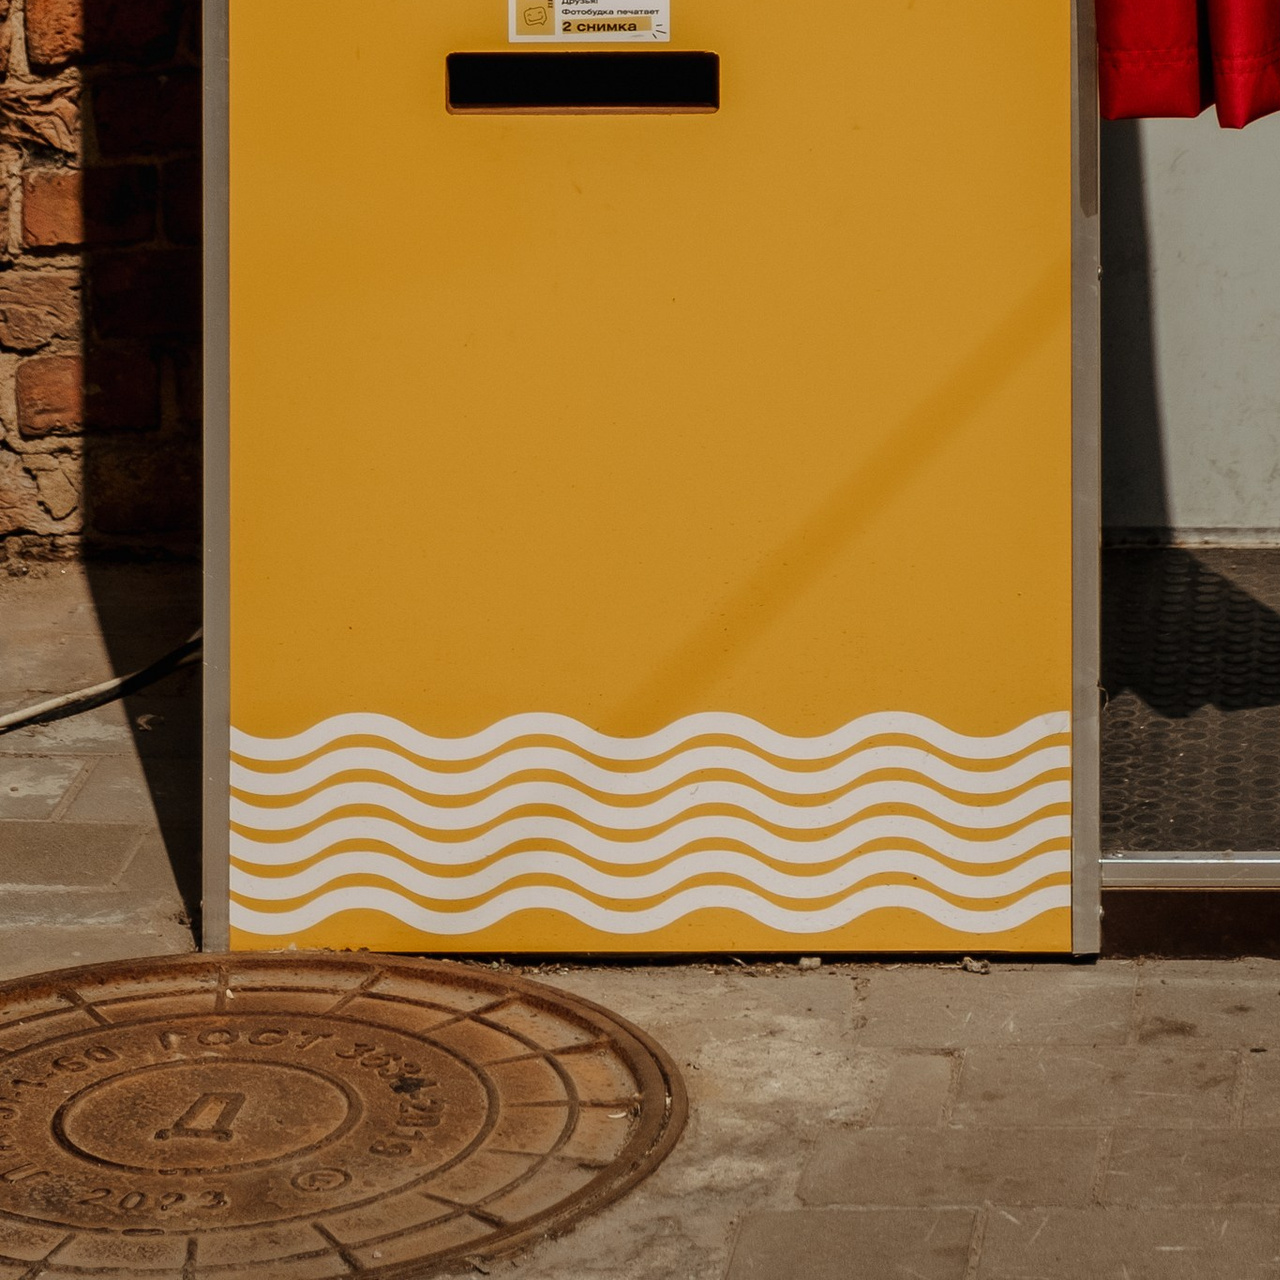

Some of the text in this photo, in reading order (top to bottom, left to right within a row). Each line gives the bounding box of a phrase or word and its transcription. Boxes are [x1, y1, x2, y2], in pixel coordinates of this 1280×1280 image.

[561, 8, 614, 16] Фотобудка
[562, 21, 637, 32] 2 снимка
[154, 1092, 247, 1142] Д
